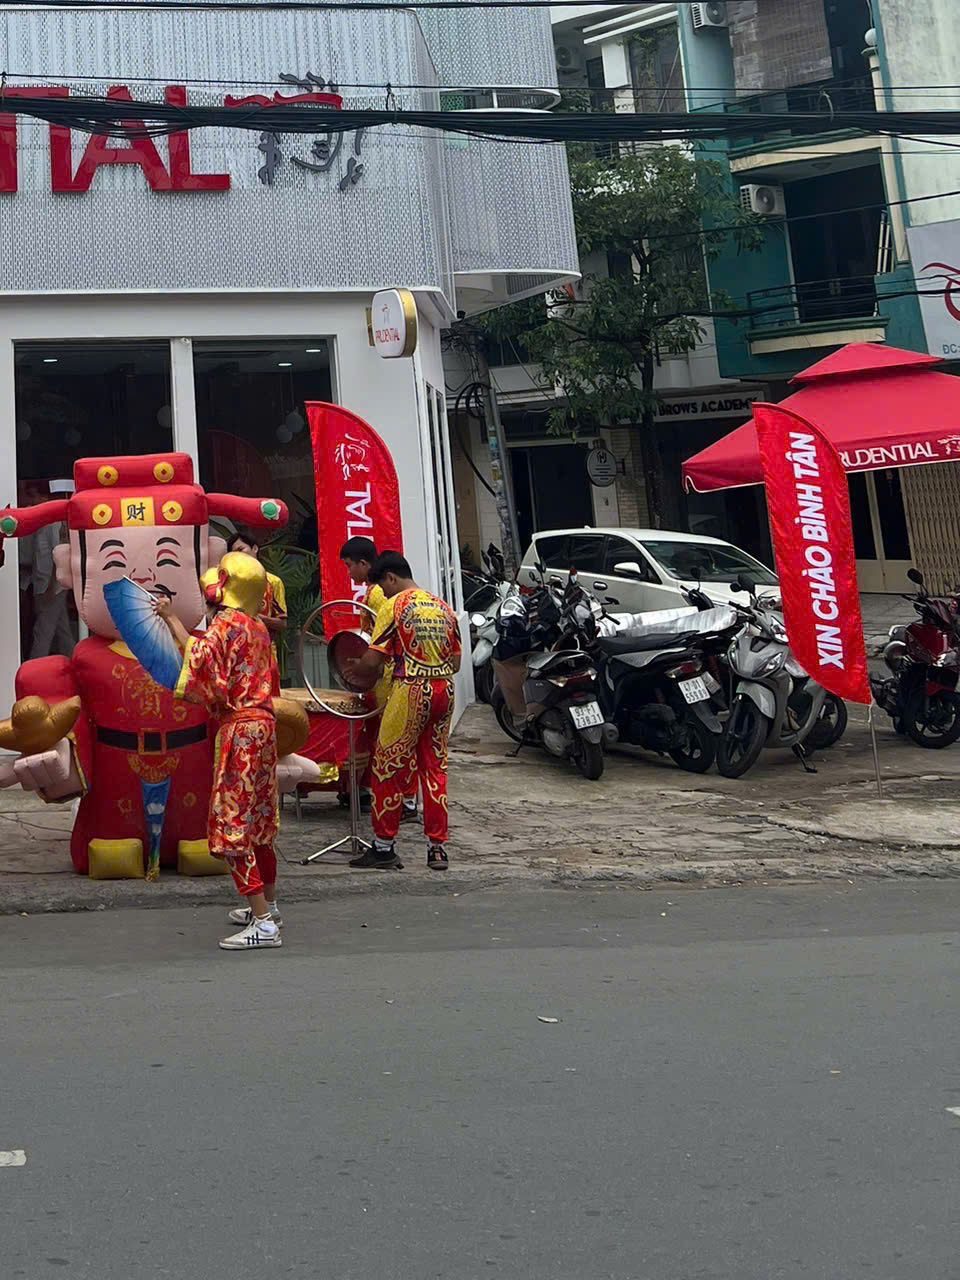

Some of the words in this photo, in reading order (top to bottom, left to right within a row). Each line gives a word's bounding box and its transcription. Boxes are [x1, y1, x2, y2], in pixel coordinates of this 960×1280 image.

[785, 431, 820, 480] TÂN
[839, 441, 939, 467] RUDENTIAL
[126, 502, 146, 521] 财
[795, 484, 829, 544] BÌNH
[801, 546, 839, 620] CHÀO
[815, 623, 845, 670] XIN
